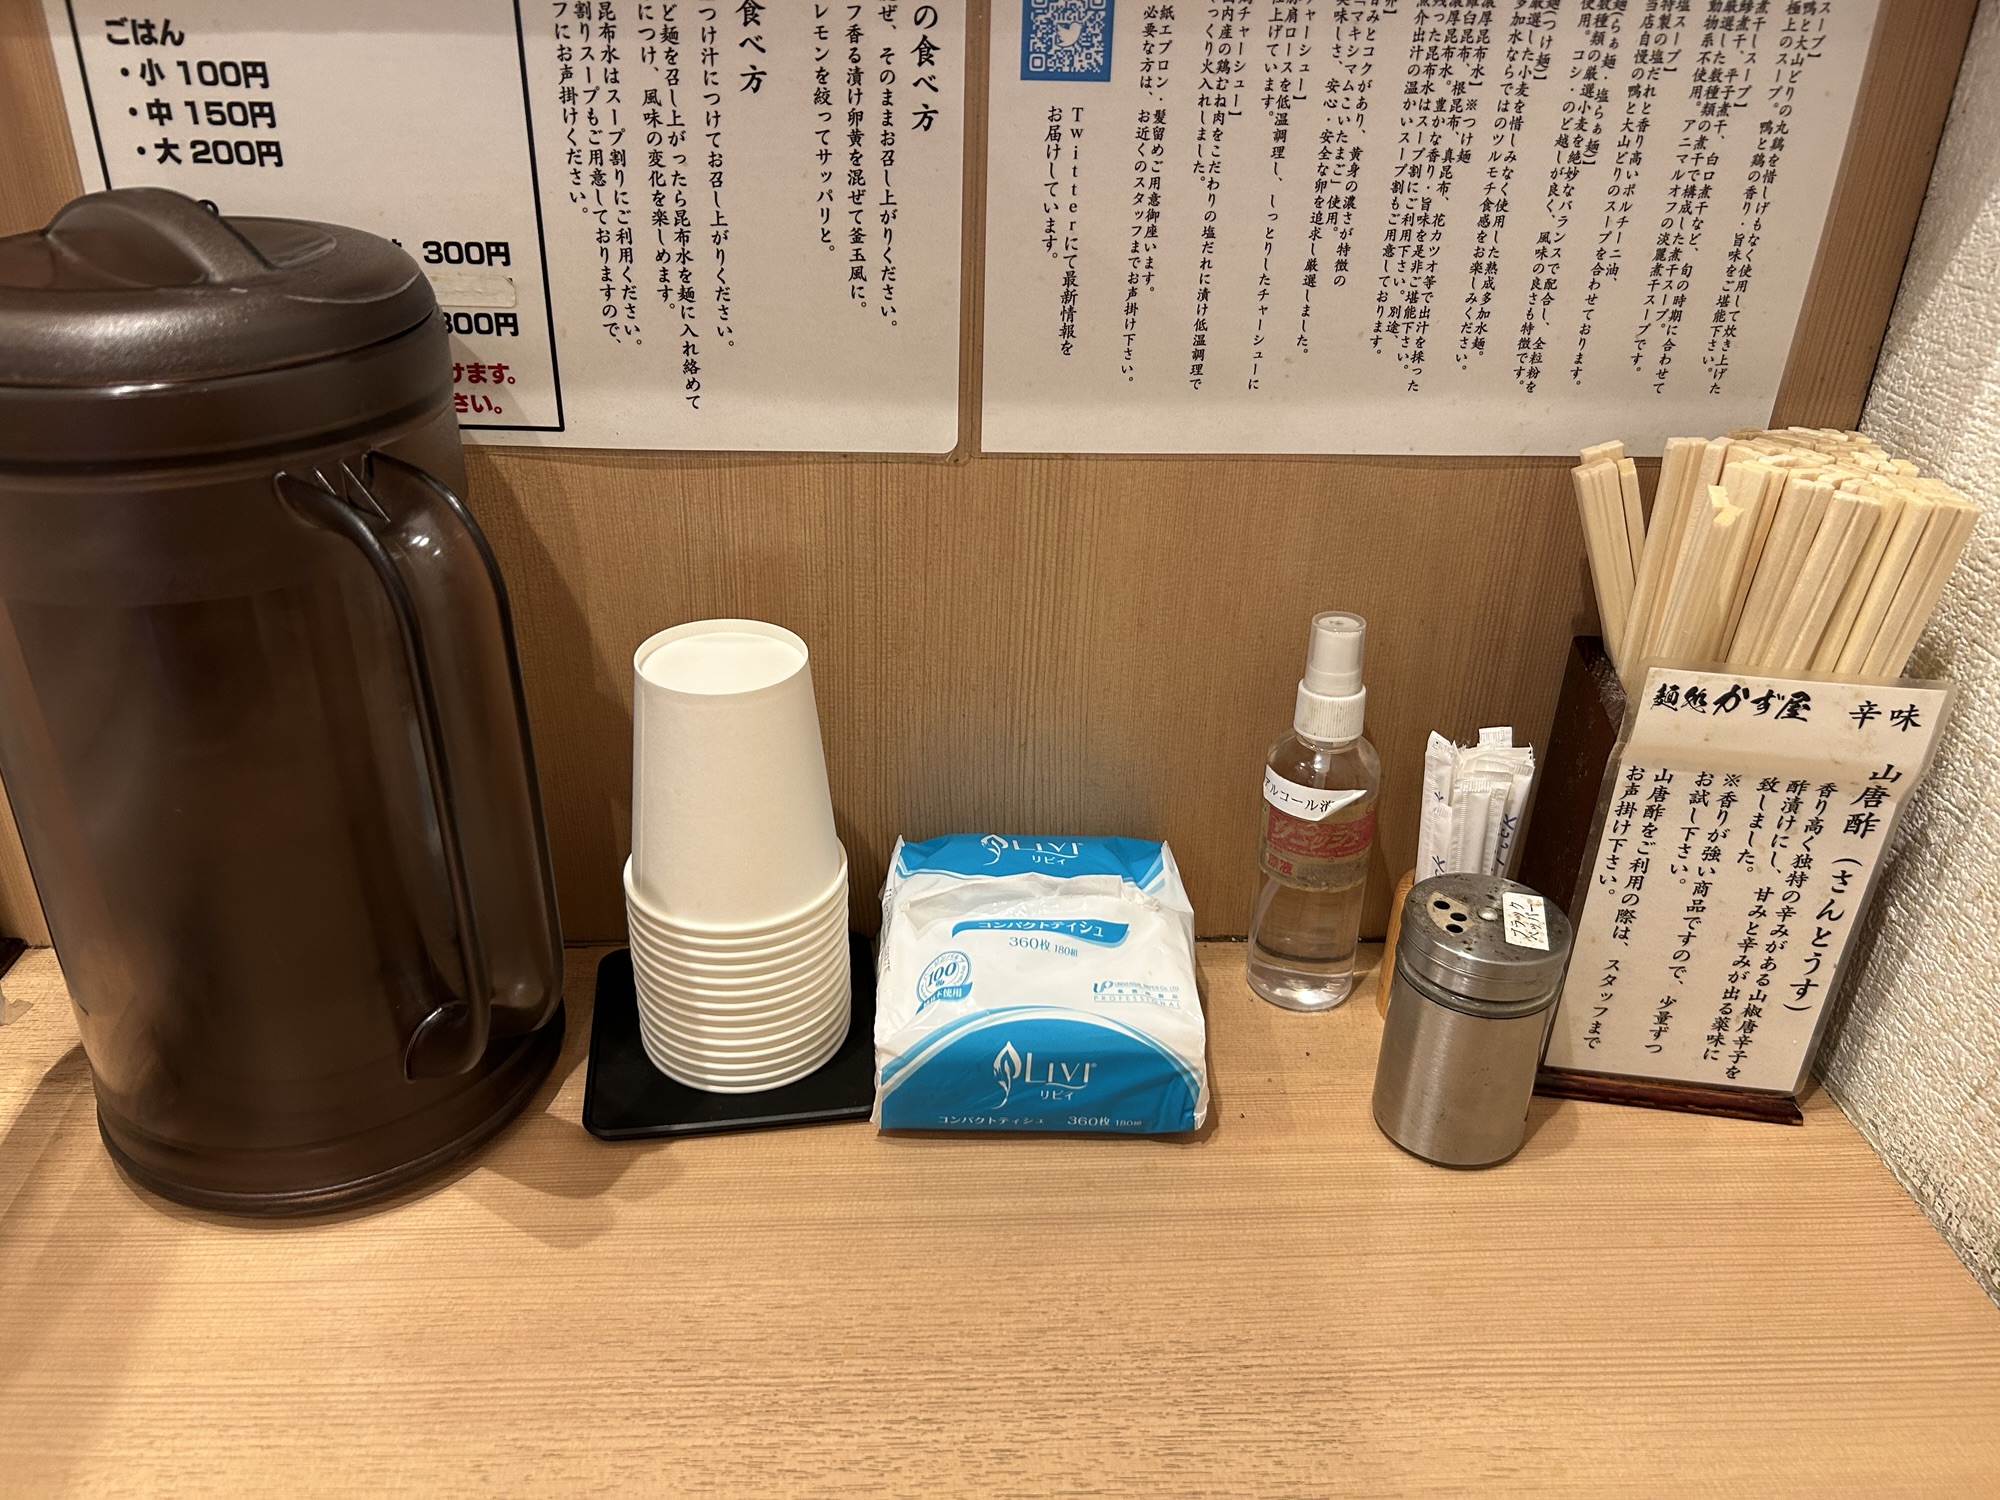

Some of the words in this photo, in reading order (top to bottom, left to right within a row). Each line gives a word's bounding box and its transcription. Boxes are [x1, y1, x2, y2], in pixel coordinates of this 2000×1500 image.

[105, 17, 185, 47] ごはん
[177, 60, 269, 90] 100円
[735, 0, 768, 94] 食べ方
[911, 4, 941, 131] の食べ方
[1228, 0, 1253, 116] チャーシュー】
[1261, 0, 1285, 116] 上げています。
[1292, 0, 1316, 100] ャーシュー】
[185, 100, 277, 129] 150円
[553, 3, 588, 213] フにお声掛けください。
[813, 4, 835, 252] レモンを絞ってサッパリと。
[1193, 0, 1219, 182] っくり火入れしました。
[192, 140, 284, 167] 200円
[844, 5, 868, 308] フ香る漬け卵黄を混ぜて釜玉風に。
[877, 0, 898, 327] ぜ、そのままお召し上がりください。
[1042, 106, 1062, 258] お届けしています。
[1190, 0, 1234, 389] 内産の鶏むね肉をこだわりの塩だれに漬け低温調理で
[1248, 0, 1298, 389] 肩ロースを低温調理し、しっとりしたチャーシューに
[422, 241, 511, 266] 300円
[1848, 700, 1922, 732] 辛味
[1599, 766, 1646, 895] お声掛け下さい。
[1670, 771, 1713, 885] お試し下さい。
[1737, 777, 1781, 873] 致しました。
[1009, 937, 1050, 952] 360枚
[1068, 1116, 1110, 1126] 360枚
